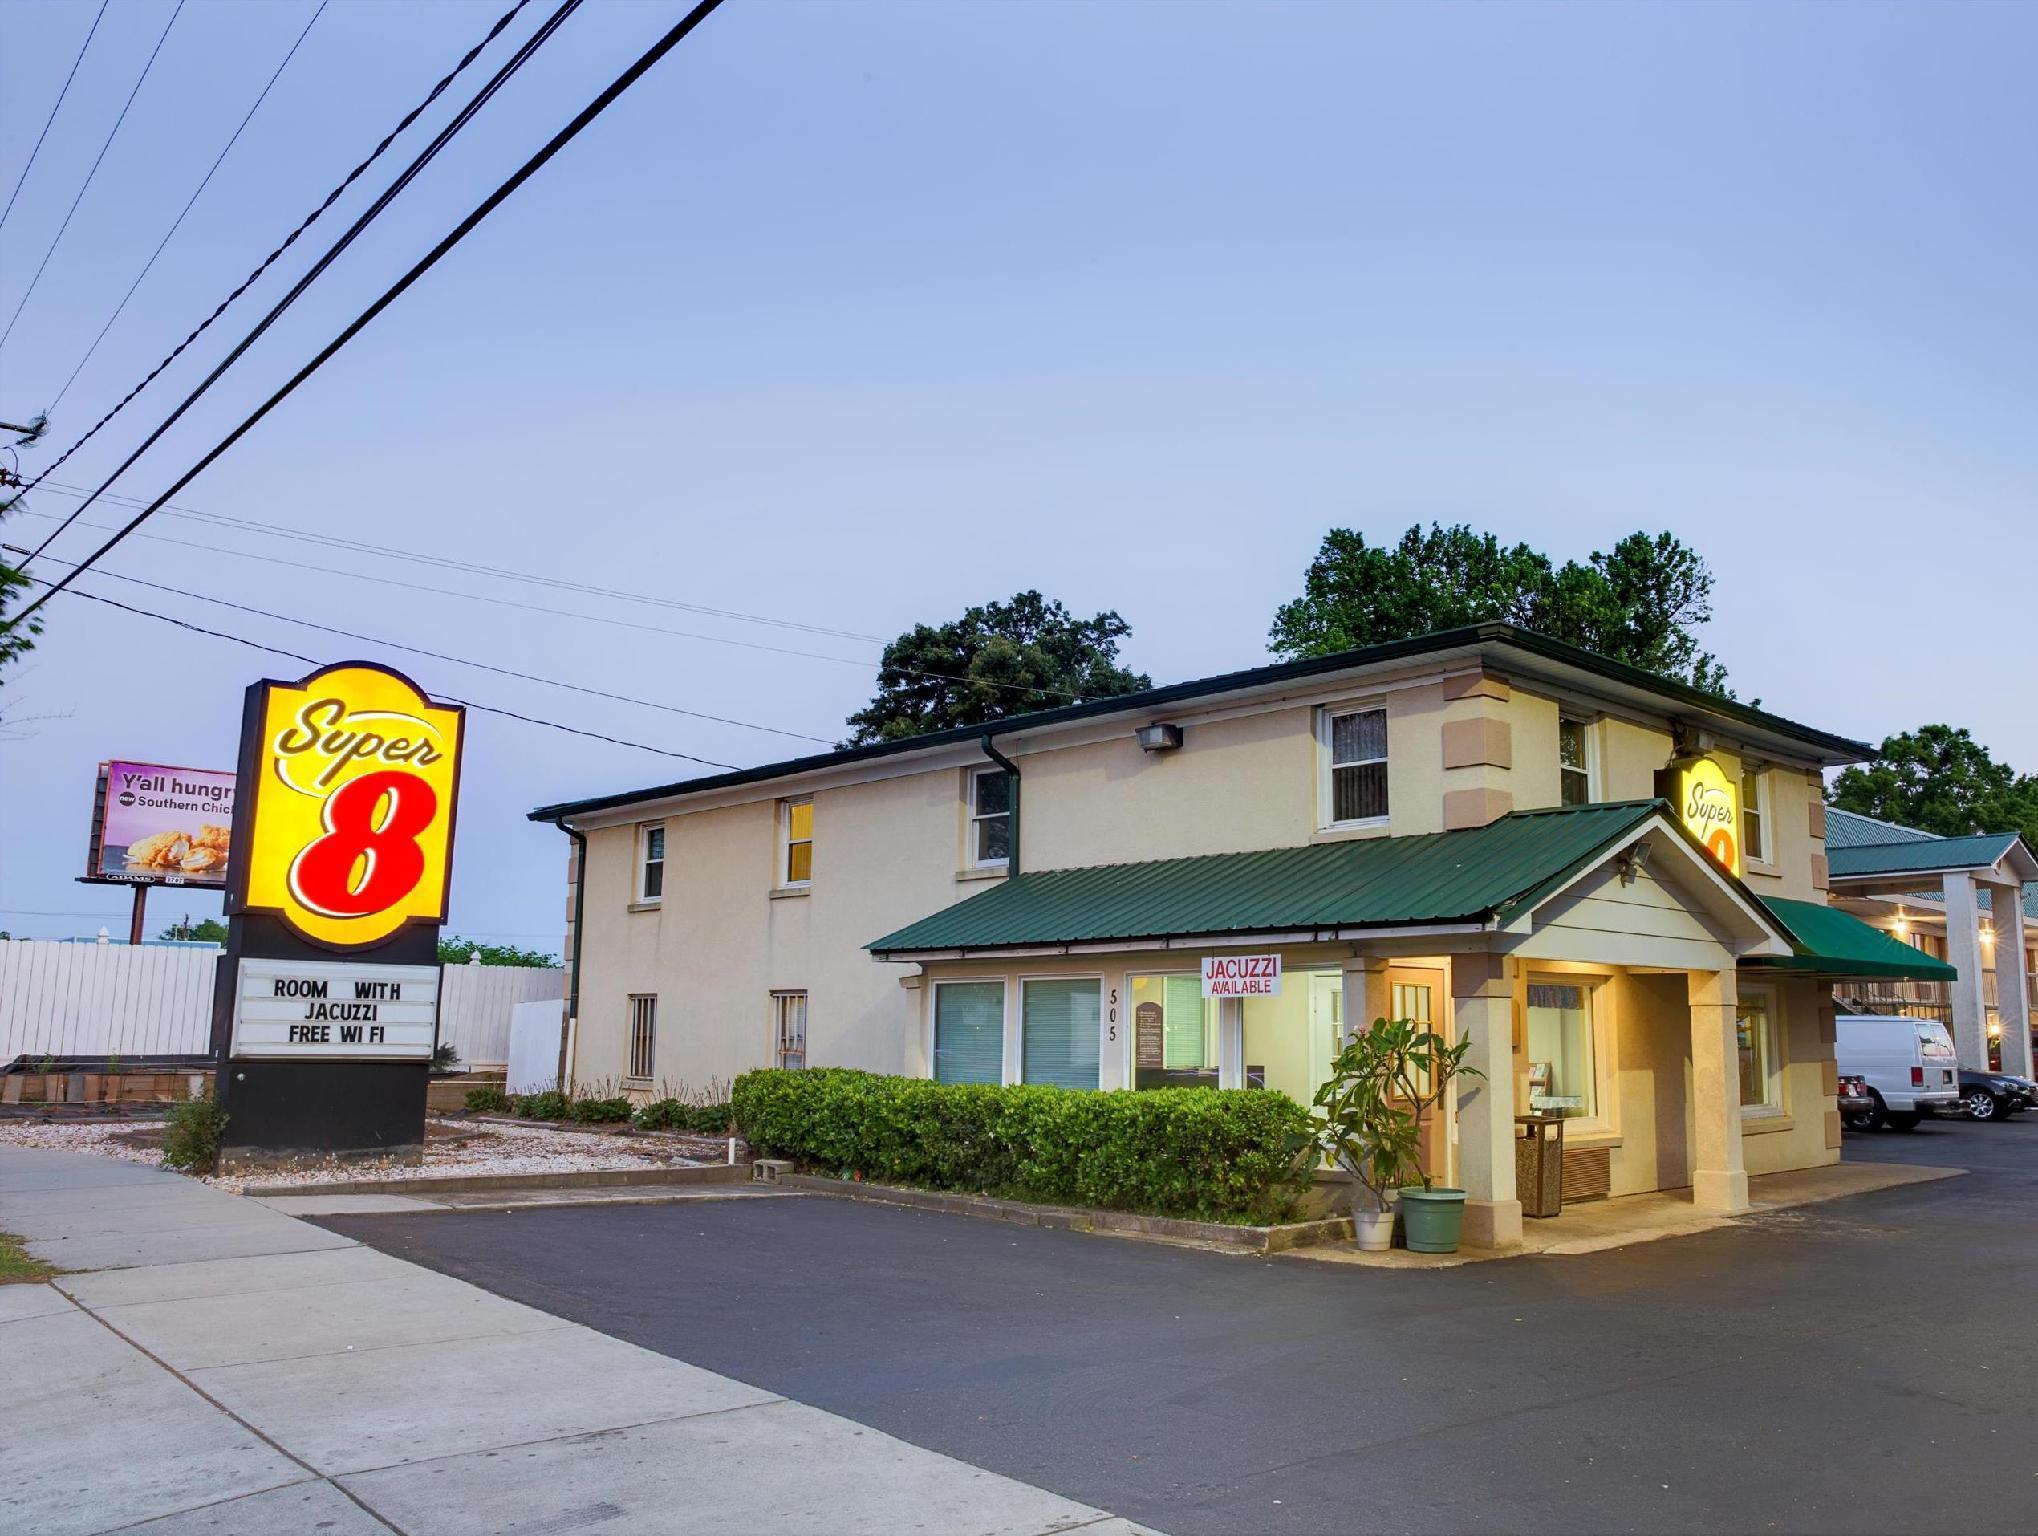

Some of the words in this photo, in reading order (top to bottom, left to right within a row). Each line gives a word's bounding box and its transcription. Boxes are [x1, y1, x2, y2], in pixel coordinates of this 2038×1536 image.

[277, 698, 443, 788] Super
[123, 773, 165, 792] Y'all
[172, 778, 236, 801] hungr
[138, 796, 198, 812] Southern
[202, 802, 233, 814] Chic
[1687, 781, 1734, 840] Super
[286, 770, 437, 920] 8
[1206, 957, 1277, 979] JACUZZI
[273, 979, 328, 999] ROOM
[354, 981, 401, 1000] WITH
[1211, 979, 1272, 995] AVAILABLE
[304, 1002, 378, 1022] JACUZZI
[289, 1025, 331, 1043] FREE
[340, 1025, 363, 1043] WI
[369, 1026, 385, 1043] FI
